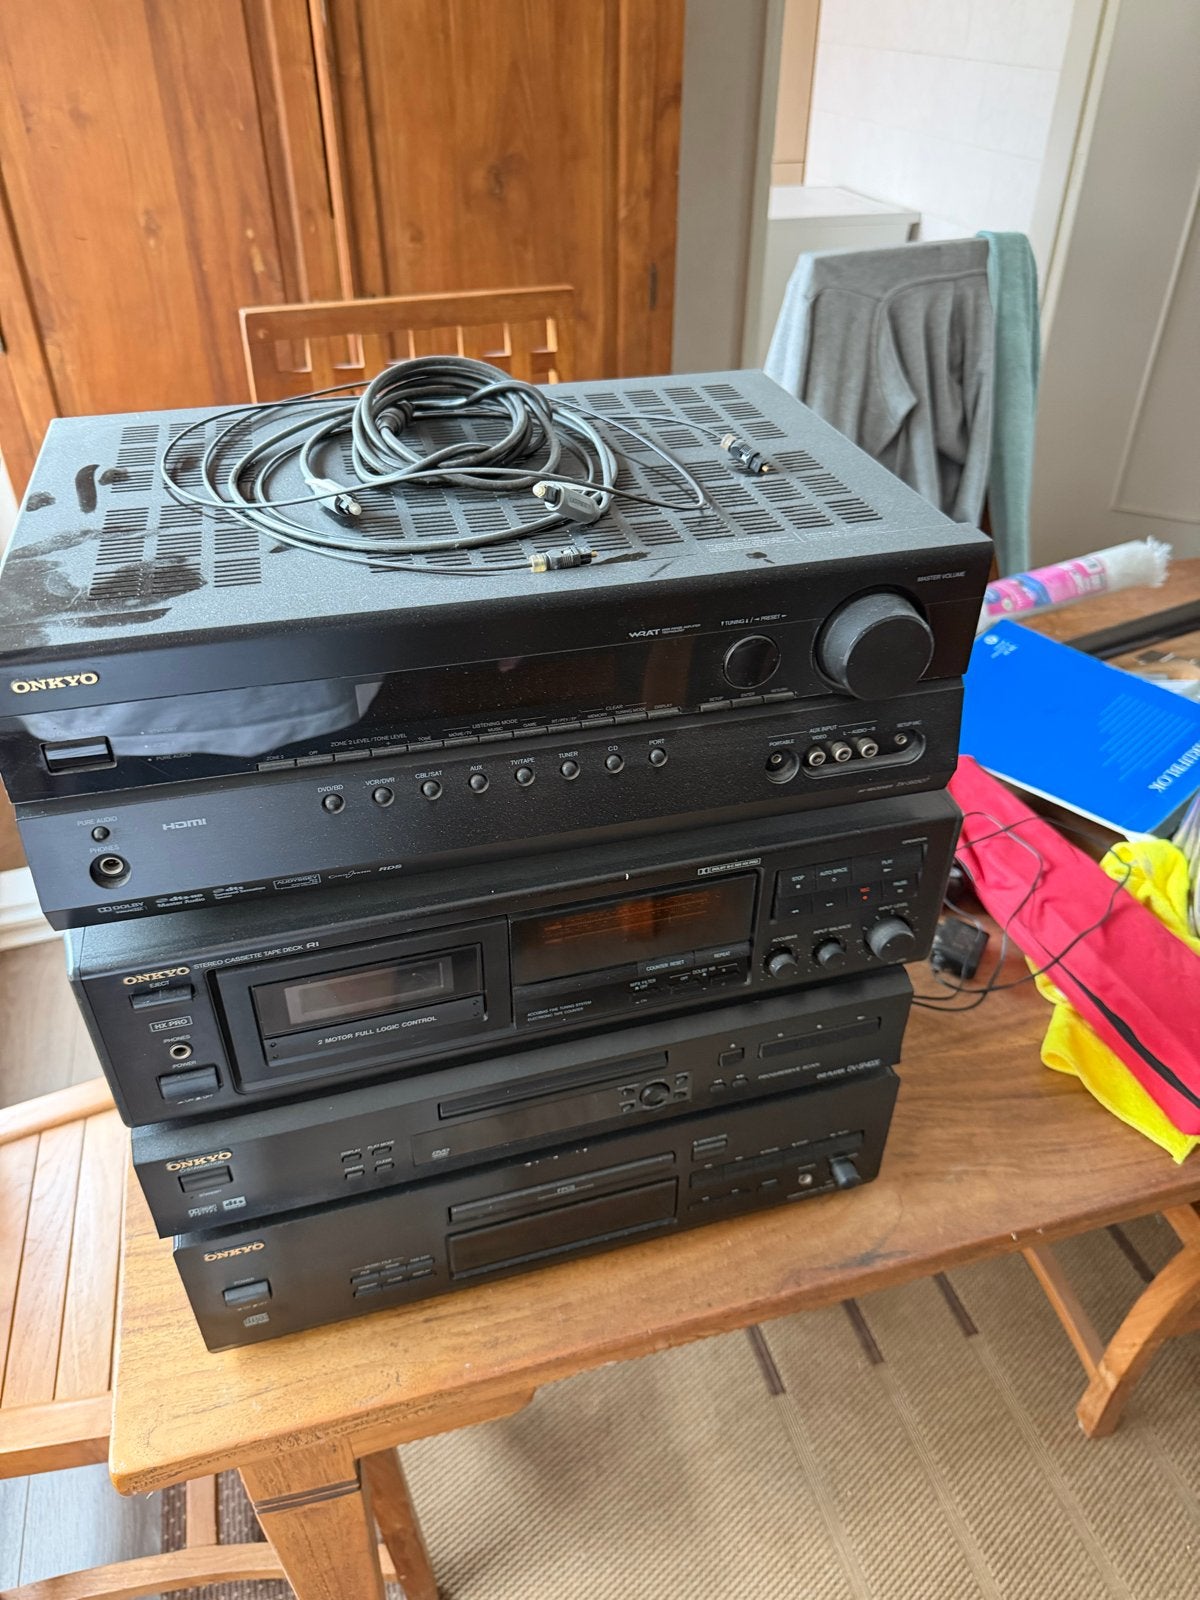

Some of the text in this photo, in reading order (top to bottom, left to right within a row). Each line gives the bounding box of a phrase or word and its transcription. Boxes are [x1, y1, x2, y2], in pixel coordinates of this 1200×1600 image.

[917, 570, 966, 582] MASTER VOLUME
[725, 618, 745, 626] TUNING
[628, 628, 661, 638] WRAT
[11, 672, 99, 693] ONKYO
[501, 718, 518, 726] MODE
[607, 744, 619, 752] CD
[558, 751, 579, 759] TUNER
[510, 757, 536, 766] TV/TAPE
[469, 764, 483, 772] AUX
[414, 770, 443, 780] CBL/SAT
[364, 776, 396, 787] VCR/DVR
[317, 784, 344, 794] DVD/BD
[76, 815, 118, 827] PURE AUDIO
[162, 817, 207, 831] HDMI
[89, 844, 121, 854] PHONES
[378, 864, 402, 872] RDS
[791, 874, 806, 882] STOP
[112, 901, 145, 911] DOLBY
[193, 959, 224, 970] STEREO
[224, 952, 263, 964] CASSETTE
[262, 948, 281, 958] TAPE
[282, 944, 304, 953] DECK
[713, 951, 731, 959] REPEAT
[646, 959, 685, 972] COUNTER RESET
[123, 967, 191, 985] ONKYO
[153, 1018, 189, 1031] HX PRO
[325, 1033, 354, 1044] MOTOR
[355, 1029, 375, 1038] FULL
[376, 1023, 400, 1034] LOGIC
[401, 1015, 438, 1029] CONTROL
[166, 1151, 232, 1172] ONKYO
[204, 1242, 265, 1262] ONKYO
